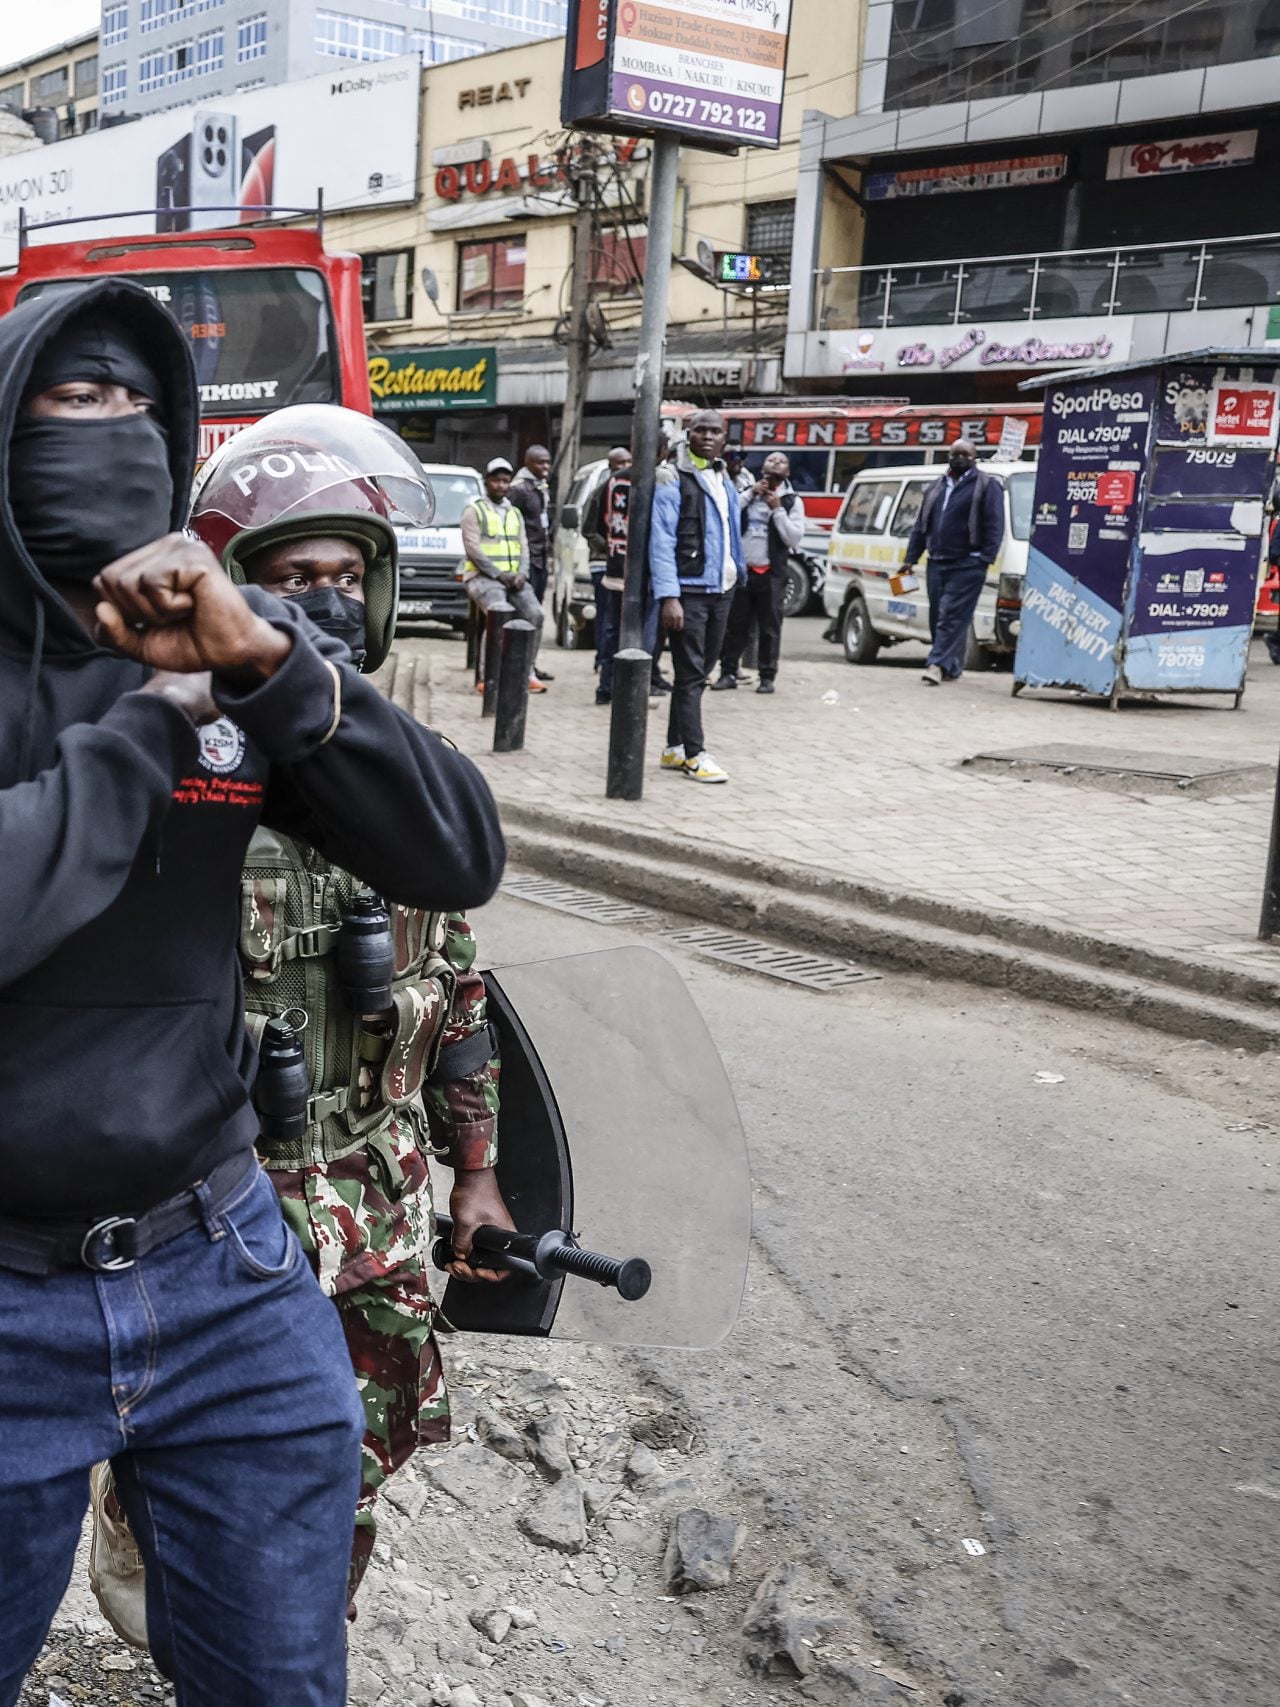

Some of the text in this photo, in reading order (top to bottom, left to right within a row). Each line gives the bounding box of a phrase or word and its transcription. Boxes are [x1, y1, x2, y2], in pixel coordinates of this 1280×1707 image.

[621, 56, 775, 97] MOMBASA NAKURU KISUMU
[678, 53, 725, 71] BRANCHES
[648, 91, 767, 132] 0727 792 122
[368, 357, 488, 398] Restaurant
[1051, 388, 1144, 420] SportPesa
[1215, 412, 1241, 425] airtel
[1252, 399, 1271, 409] TOP
[1253, 409, 1267, 418] UP
[1246, 418, 1271, 428] HERE
[1047, 581, 1111, 633] TAKE EVERY
[1023, 587, 1115, 662] OPPORTUNITY
